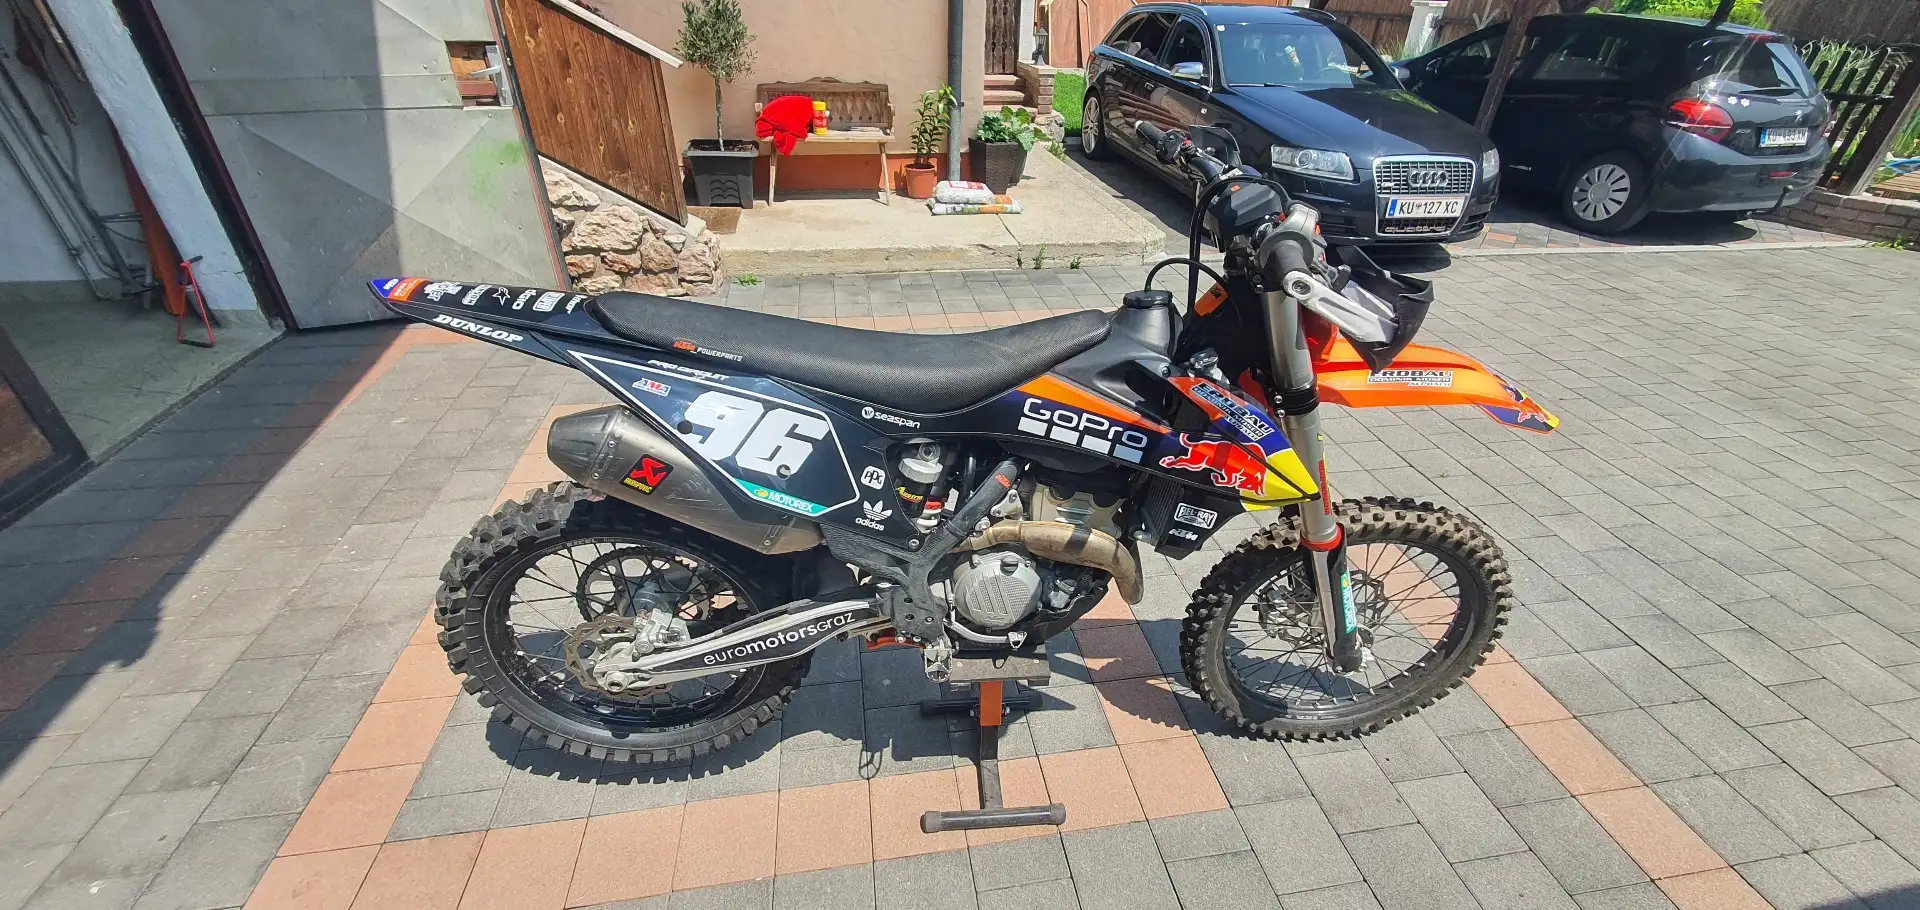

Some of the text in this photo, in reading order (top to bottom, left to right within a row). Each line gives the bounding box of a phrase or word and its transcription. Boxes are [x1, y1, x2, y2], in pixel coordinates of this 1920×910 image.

[1399, 201, 1458, 214] KU 127 XC
[433, 314, 523, 342] DUNLOP
[697, 346, 743, 362] POWERPARTS
[874, 410, 921, 429] seaspan
[1023, 398, 1148, 448] GoPro
[678, 390, 830, 476] 96
[768, 492, 813, 513] MOTOREX
[855, 517, 885, 531] adidas
